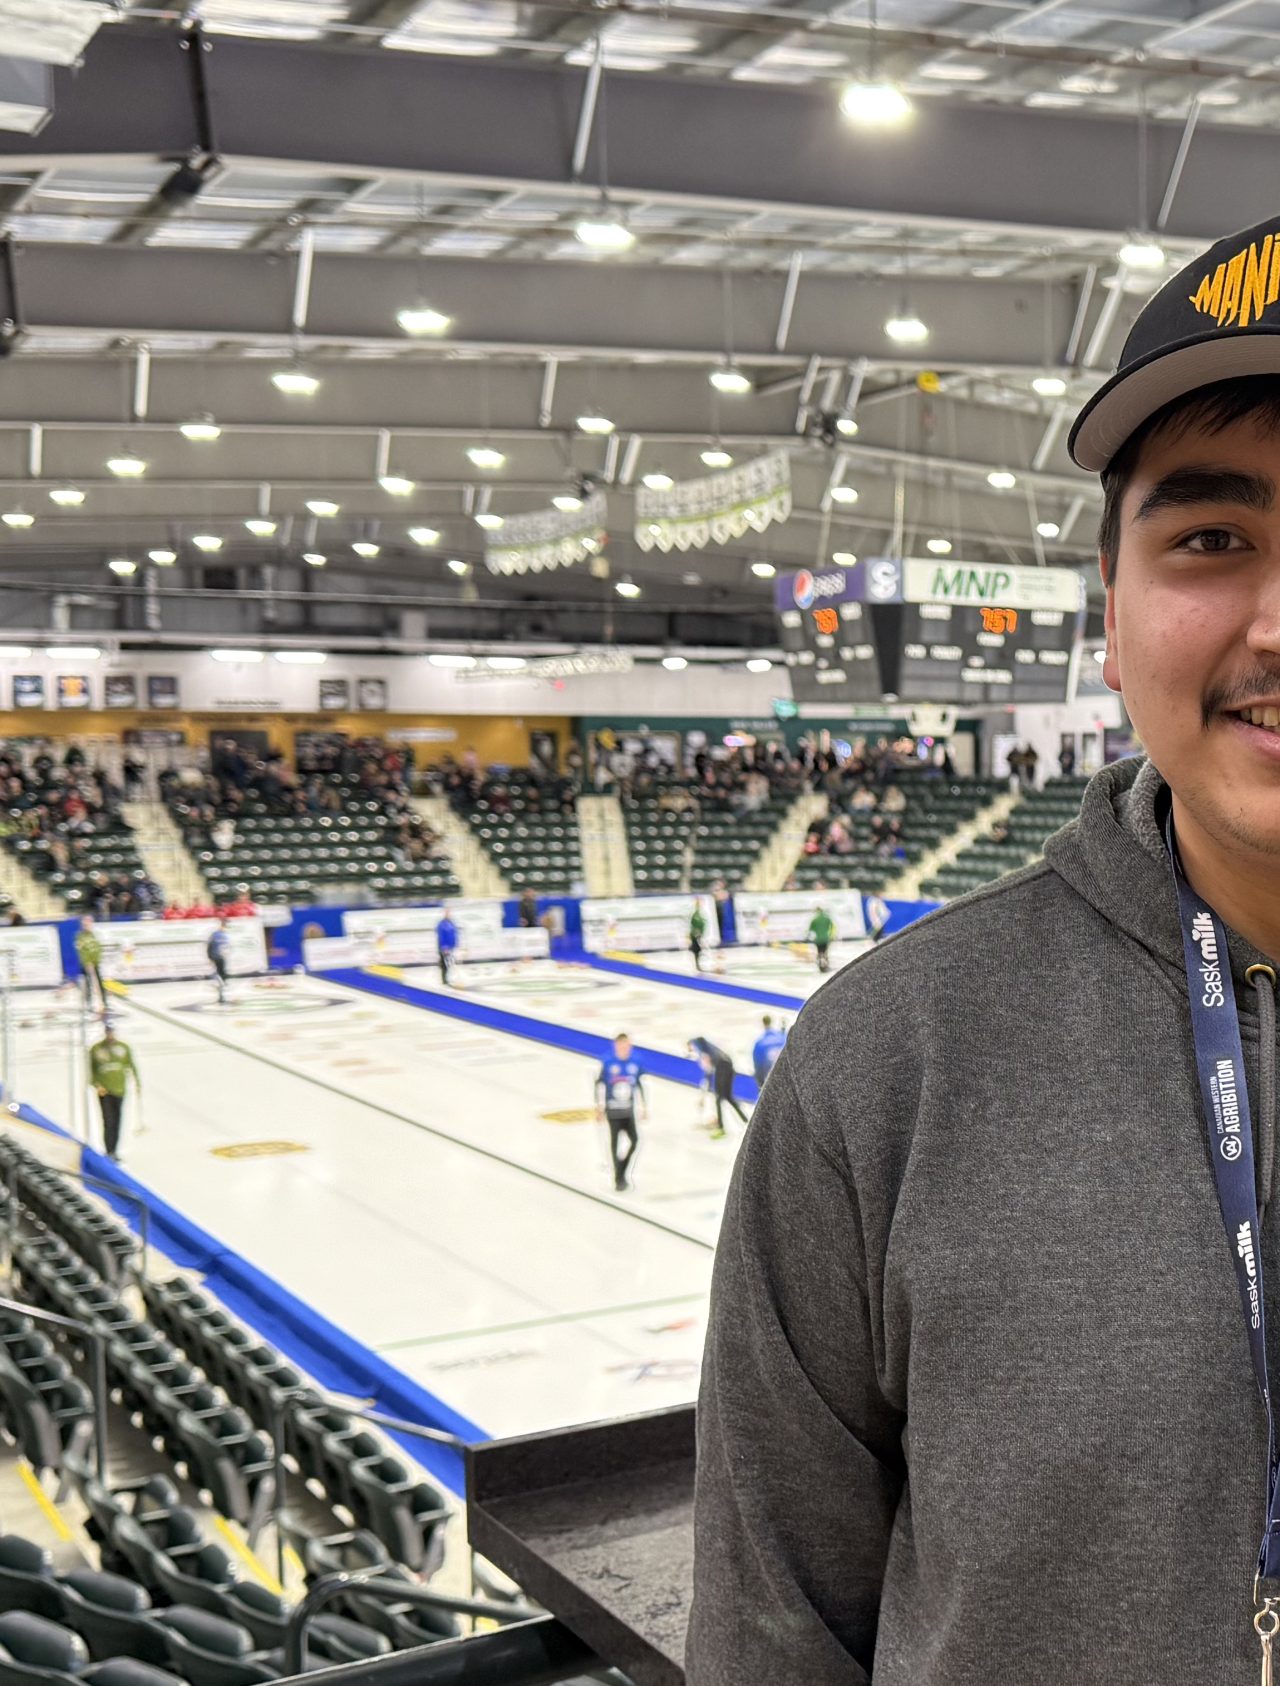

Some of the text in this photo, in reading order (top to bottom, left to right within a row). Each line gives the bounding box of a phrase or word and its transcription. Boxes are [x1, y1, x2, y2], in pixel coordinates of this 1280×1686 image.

[932, 567, 1011, 599] MNP
[1210, 1076, 1224, 1134] CANADIAN WESTERN
[1217, 1059, 1241, 1132] AGRIBITION
